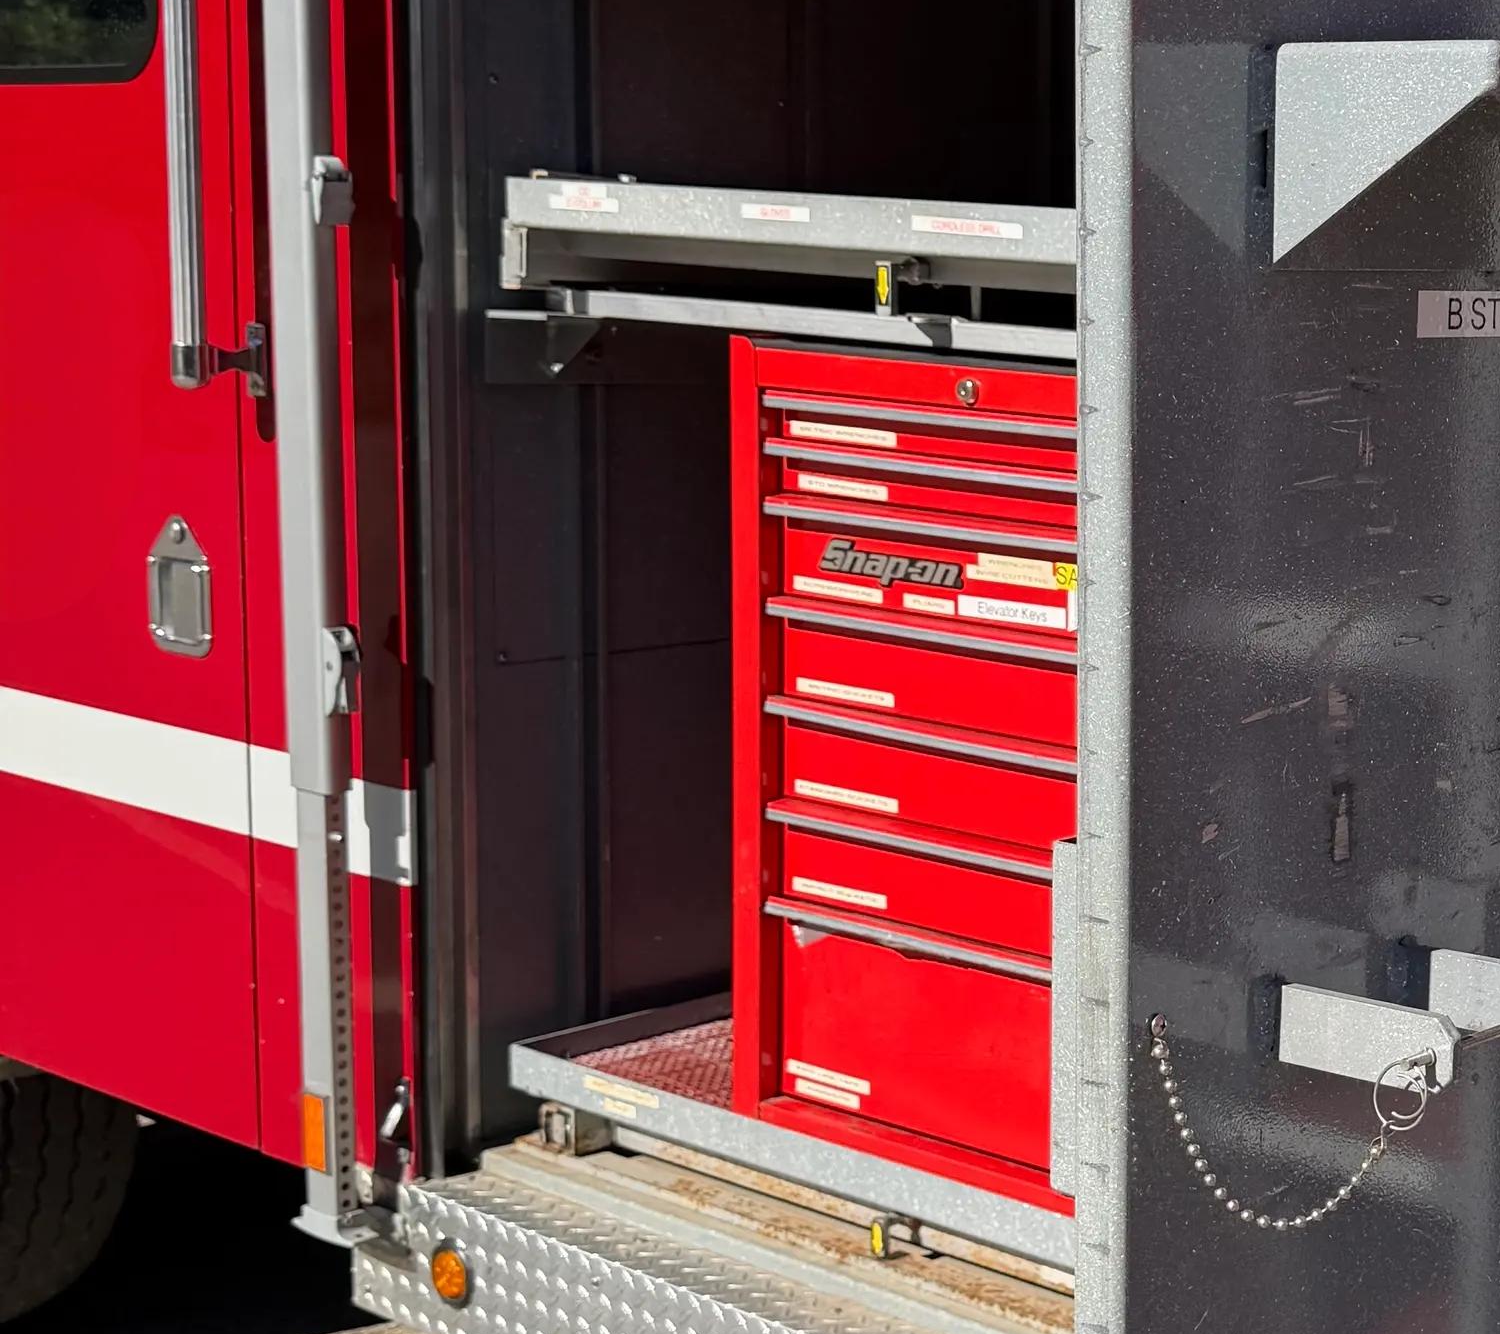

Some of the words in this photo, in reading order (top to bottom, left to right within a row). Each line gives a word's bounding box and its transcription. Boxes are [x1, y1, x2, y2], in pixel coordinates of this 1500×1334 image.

[1447, 297, 1463, 331] B
[819, 538, 961, 587] Snap-on
[976, 600, 1019, 619] Elevator
[1021, 606, 1048, 624] Keys
